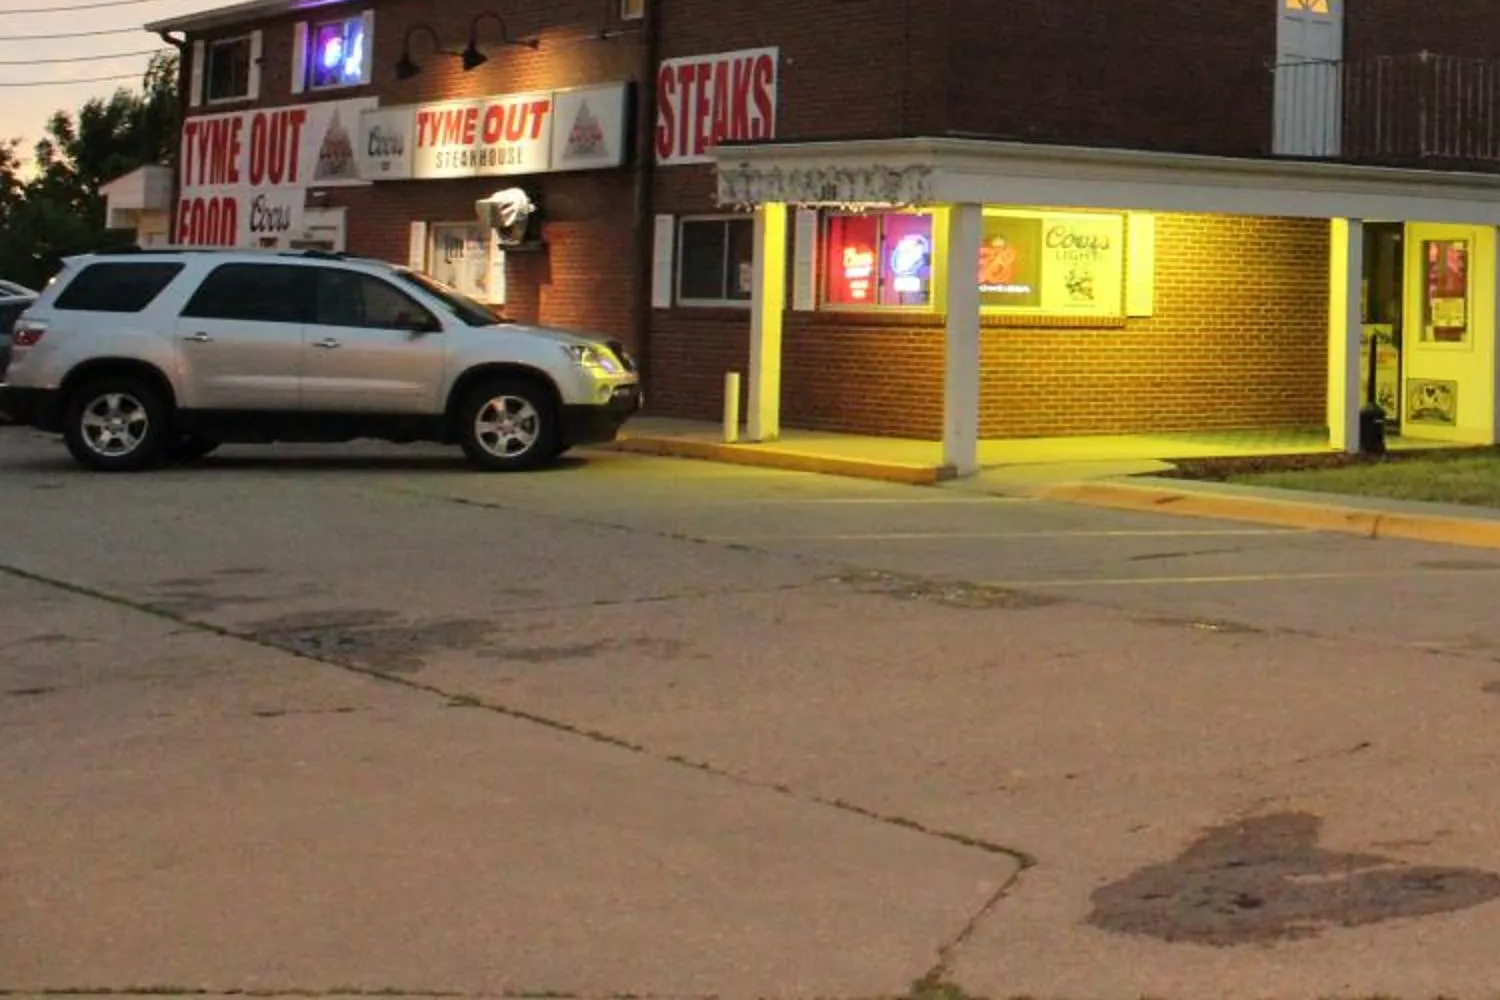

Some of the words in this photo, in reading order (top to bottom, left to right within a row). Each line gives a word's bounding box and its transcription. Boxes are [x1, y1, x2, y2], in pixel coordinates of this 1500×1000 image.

[416, 107, 479, 148] TYME
[482, 101, 550, 145] OUT
[657, 55, 773, 158] STEAKS
[185, 117, 242, 186] TYME
[250, 110, 306, 186] OUT
[436, 148, 524, 169] STEAKHOUSE
[1046, 225, 1110, 250] Coors
